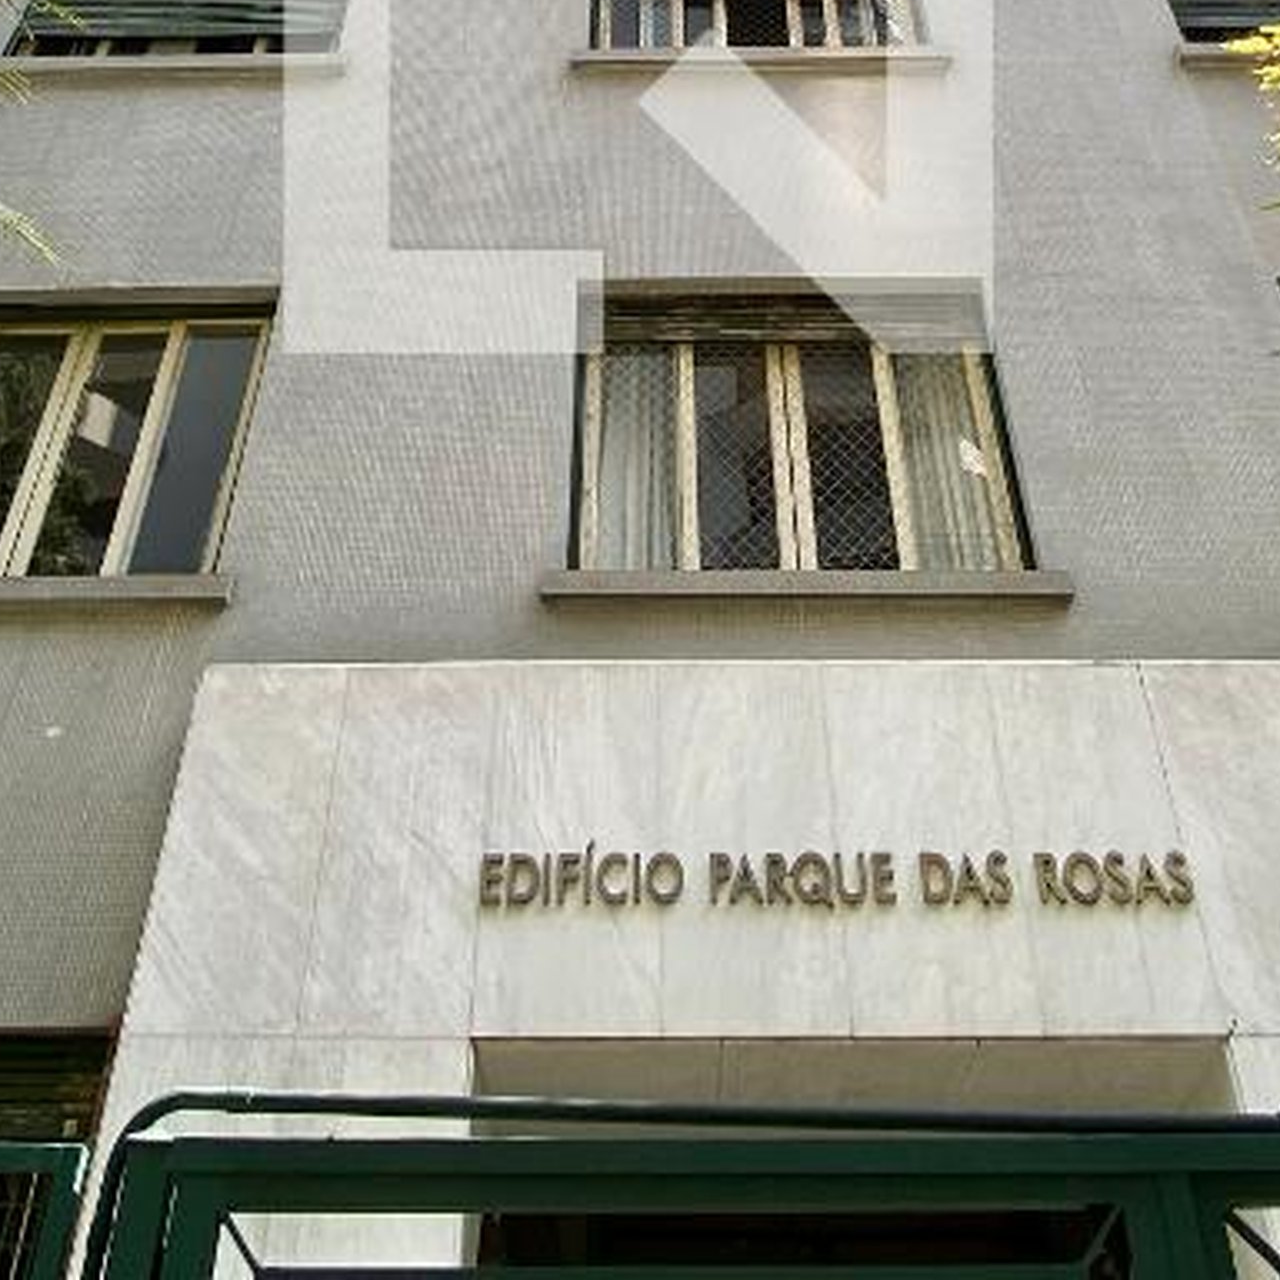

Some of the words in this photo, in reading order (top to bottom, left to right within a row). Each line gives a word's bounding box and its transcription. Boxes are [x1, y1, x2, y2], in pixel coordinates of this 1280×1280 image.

[478, 841, 684, 908] EDIFÍCIO
[708, 851, 897, 910] PARQUE
[919, 851, 1014, 908] DAS
[1032, 851, 1196, 908] ROSAS
